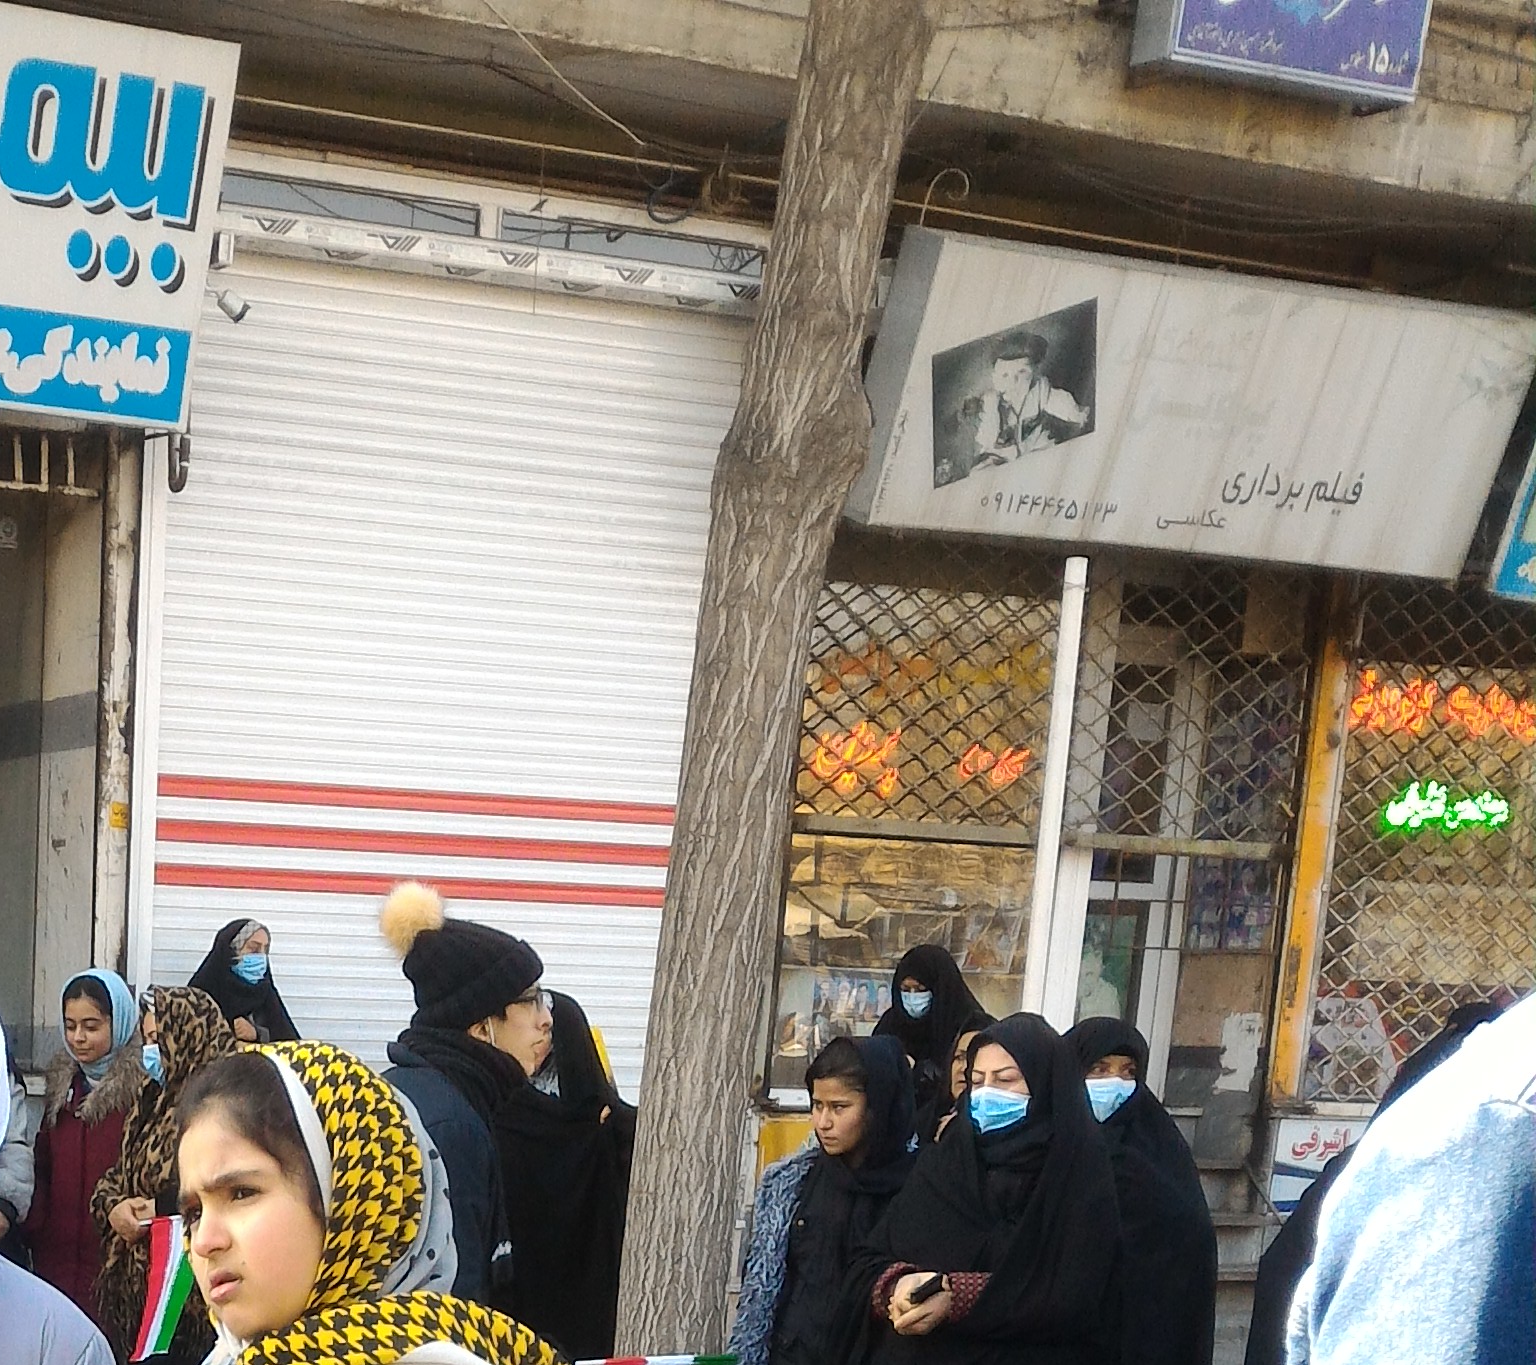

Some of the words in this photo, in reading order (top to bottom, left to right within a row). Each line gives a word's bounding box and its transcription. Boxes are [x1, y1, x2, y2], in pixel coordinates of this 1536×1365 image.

[1221, 462, 1305, 510] برداری
[1305, 470, 1366, 517] فیلم
[1156, 508, 1228, 530] عکاسی
